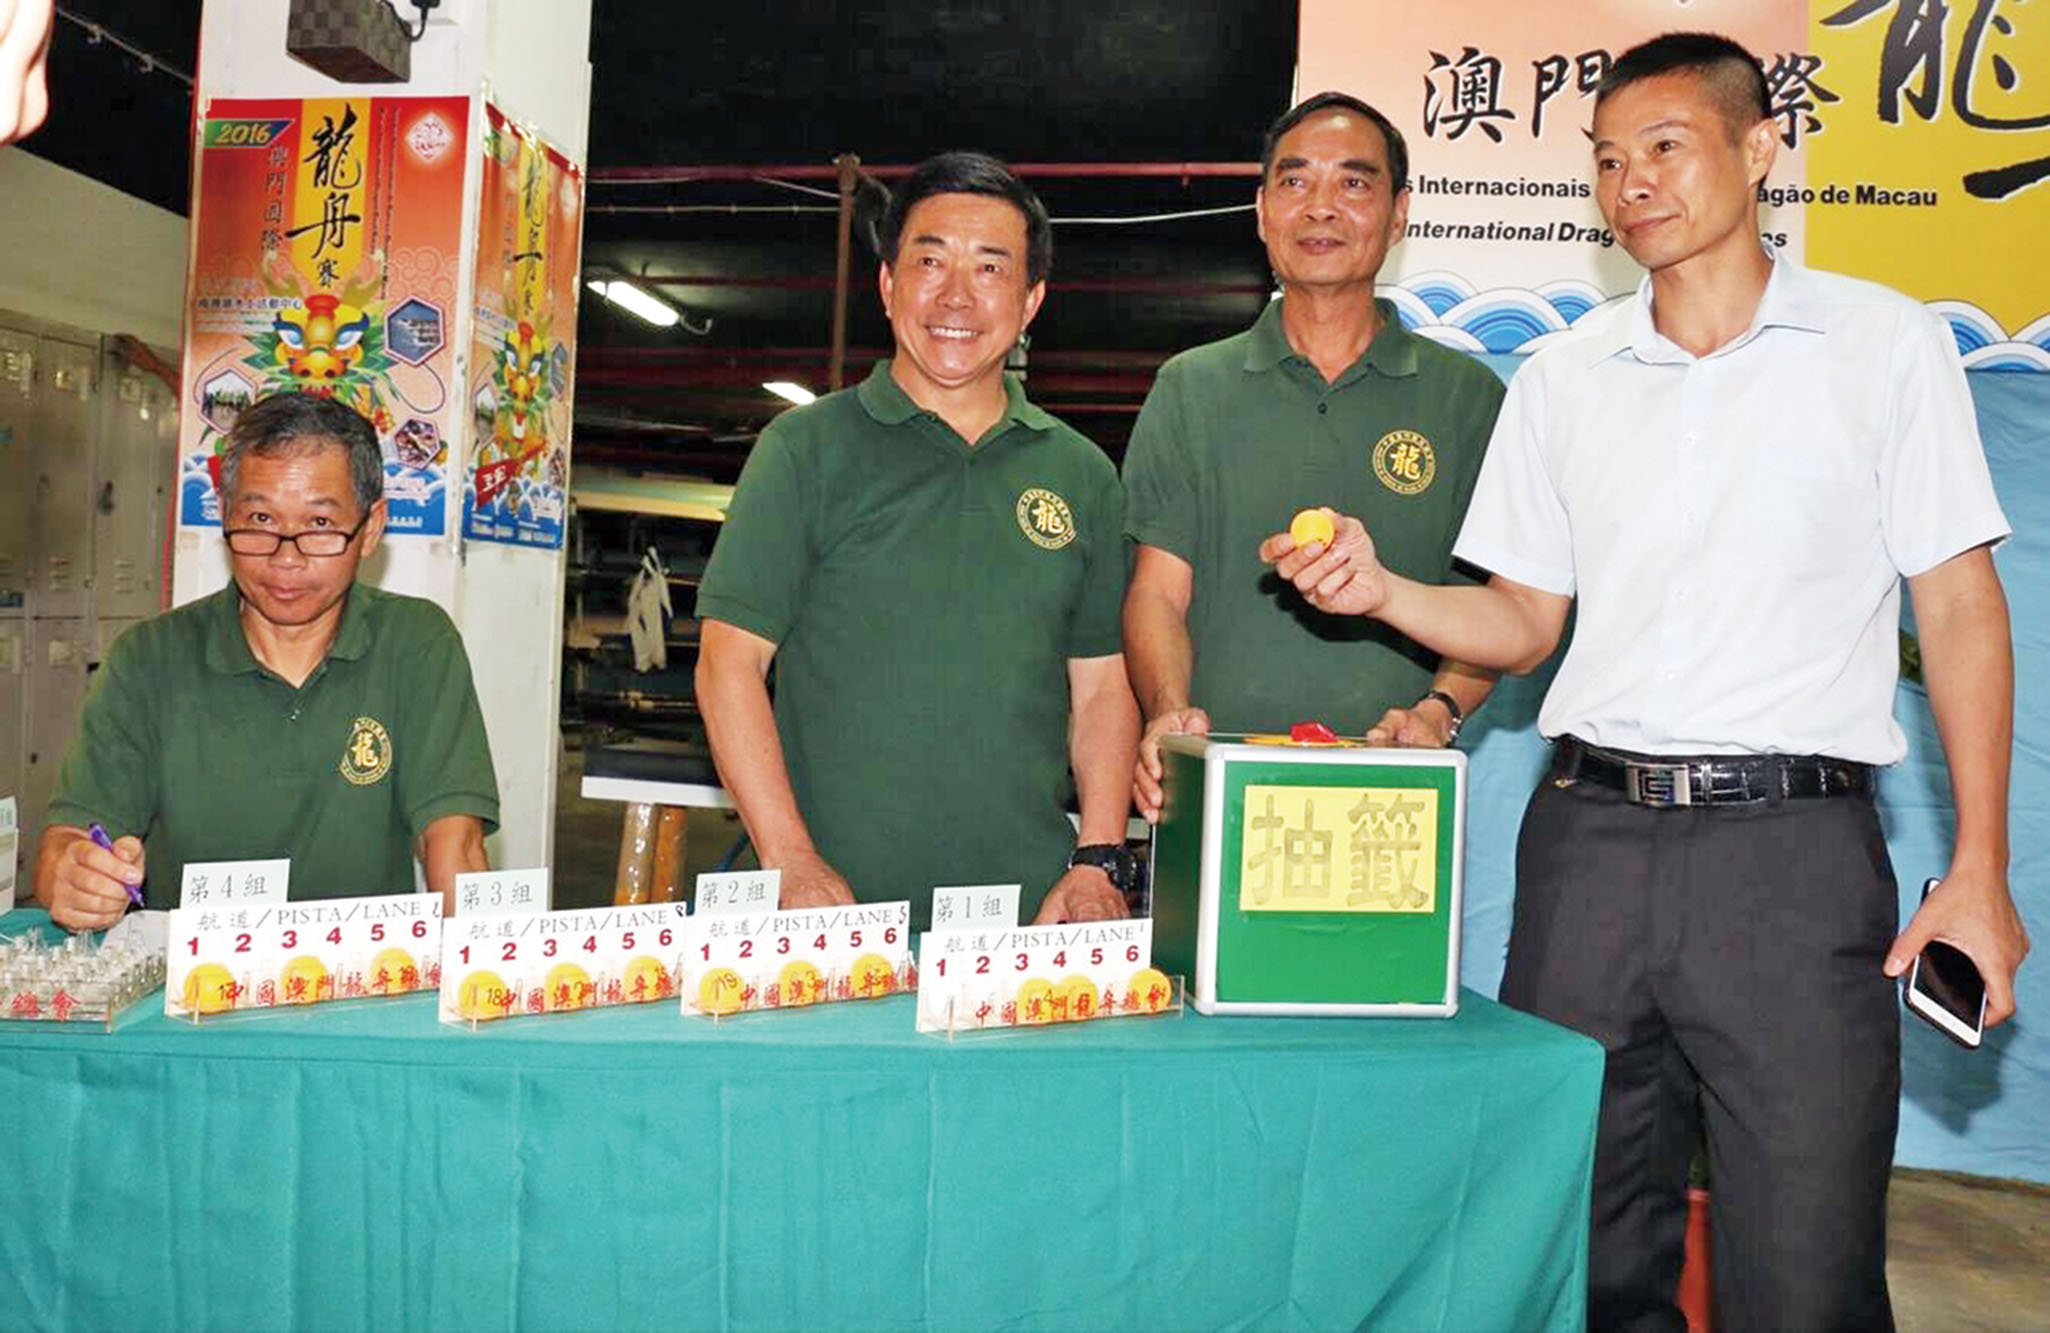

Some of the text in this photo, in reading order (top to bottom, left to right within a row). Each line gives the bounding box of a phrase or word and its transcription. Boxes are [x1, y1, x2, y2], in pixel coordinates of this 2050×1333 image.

[215, 123, 272, 144] 2016
[1419, 175, 1591, 199] Internacionais
[1758, 185, 1816, 207] agão
[1820, 185, 1851, 204] de
[1856, 185, 1938, 206] Macau
[1405, 221, 1616, 248] nternational Drag
[1247, 793, 1431, 910] 抽籤
[189, 874, 269, 902] 第4組
[463, 881, 533, 910] 第3組
[702, 879, 767, 908] 第2組
[936, 895, 1003, 922] 第1組
[187, 920, 427, 956] 1 2 3 4 5 6
[459, 928, 673, 964] 1 2 3 4 5 6
[700, 927, 897, 961] 1 2 3 4 5 6
[936, 945, 1139, 976] 1 2 3 4 5 6
